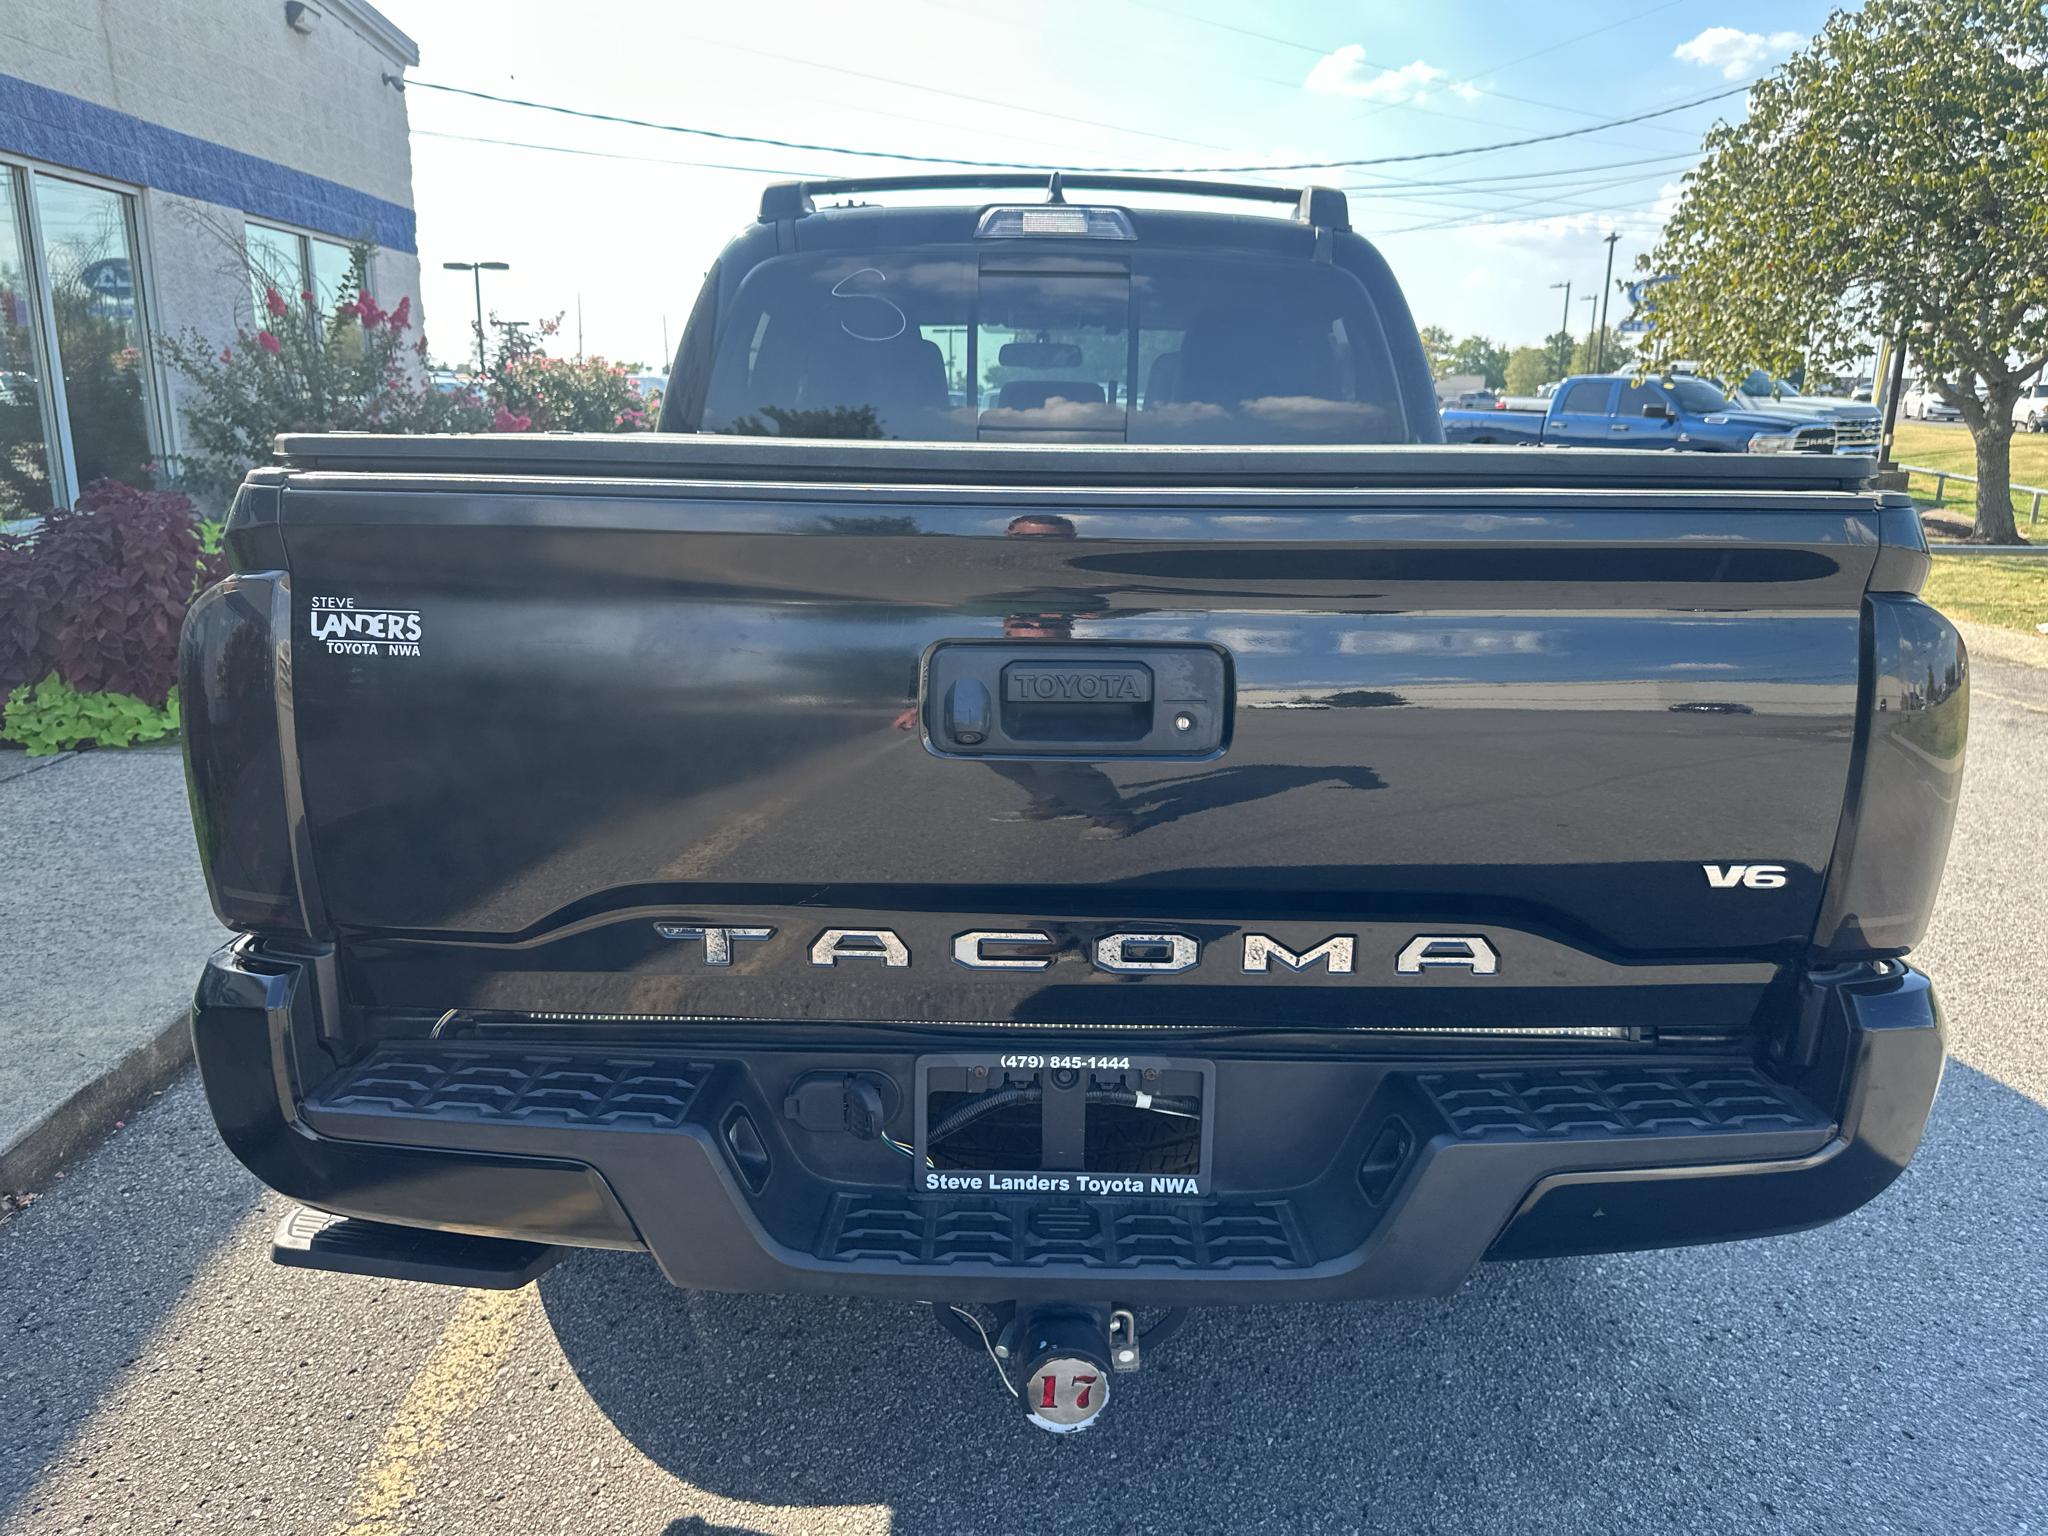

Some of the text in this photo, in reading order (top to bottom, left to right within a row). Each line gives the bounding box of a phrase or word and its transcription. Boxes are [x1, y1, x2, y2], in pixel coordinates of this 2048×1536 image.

[311, 596, 354, 609] STEVE
[310, 611, 422, 641] LANDERS
[326, 642, 421, 657] TOYOTA NWA
[1014, 674, 1142, 699] TOYOTA
[1702, 864, 1786, 889] V6
[653, 921, 1501, 976] TACOMA
[1000, 1055, 1130, 1069] (479) 845-1444
[926, 1173, 1199, 1195] Steve Landers Toyota NWA
